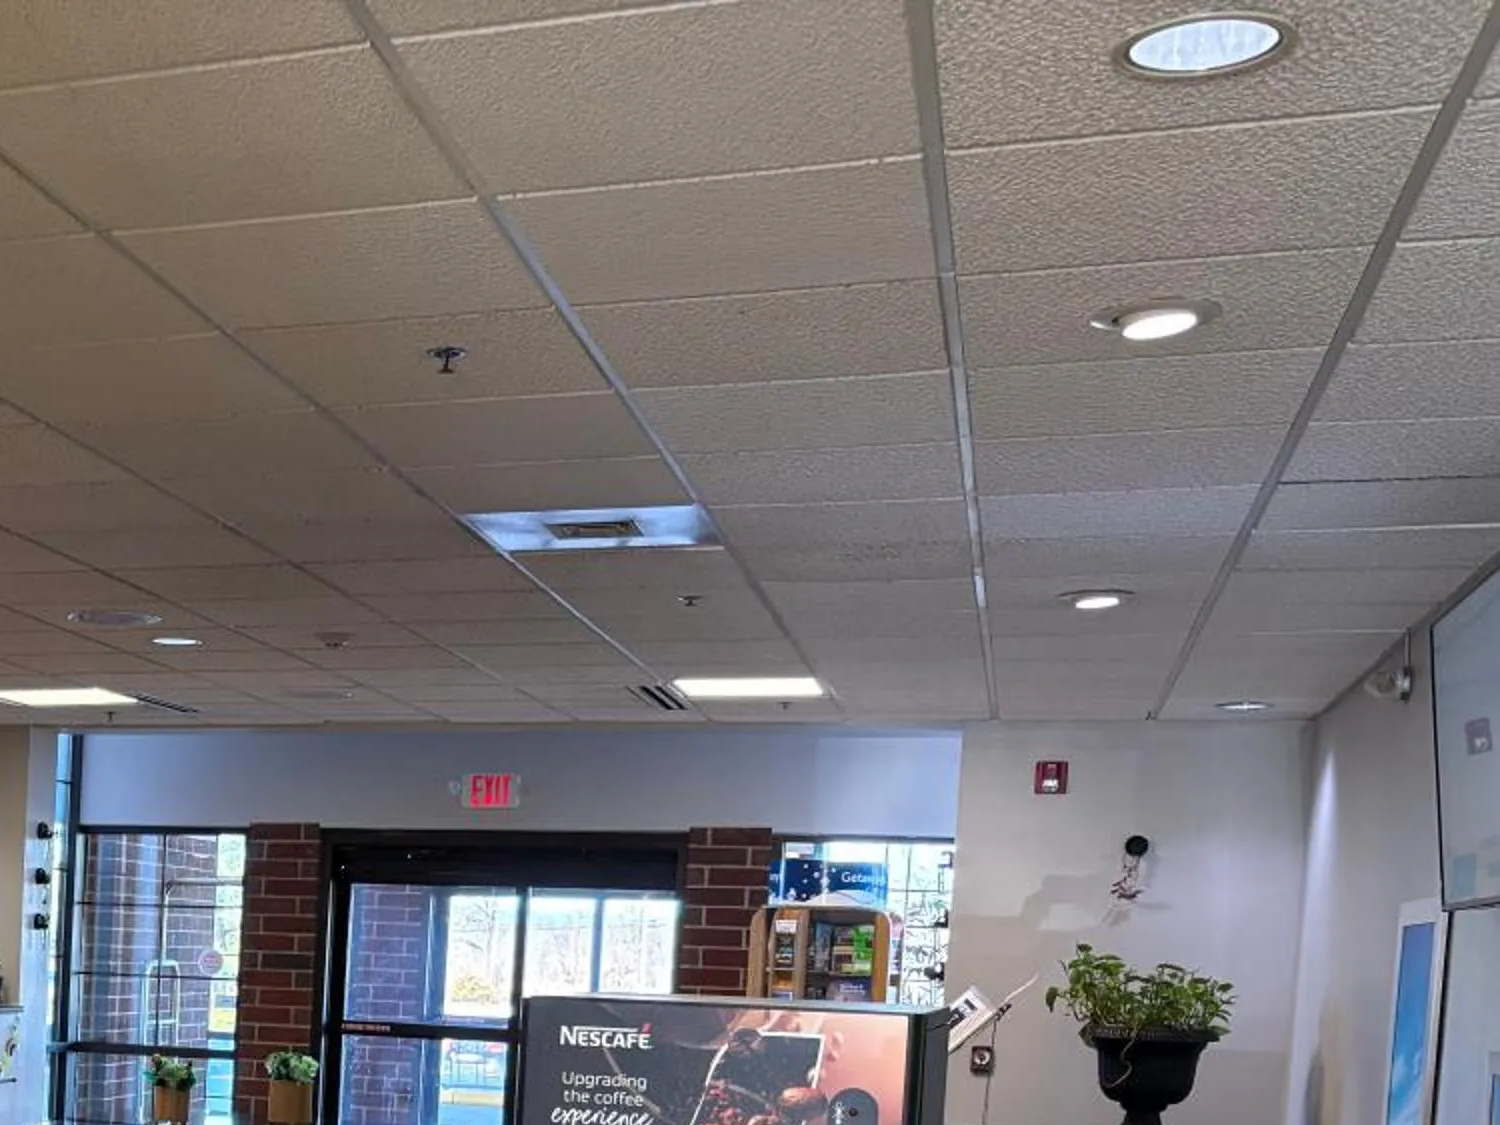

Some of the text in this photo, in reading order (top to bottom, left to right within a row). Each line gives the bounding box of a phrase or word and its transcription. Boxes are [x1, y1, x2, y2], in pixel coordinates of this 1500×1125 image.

[470, 775, 510, 805] EXIT
[559, 1023, 653, 1049] NESCAFÉ
[561, 1071, 648, 1092] Upgrading
[563, 1090, 644, 1107] the coffee
